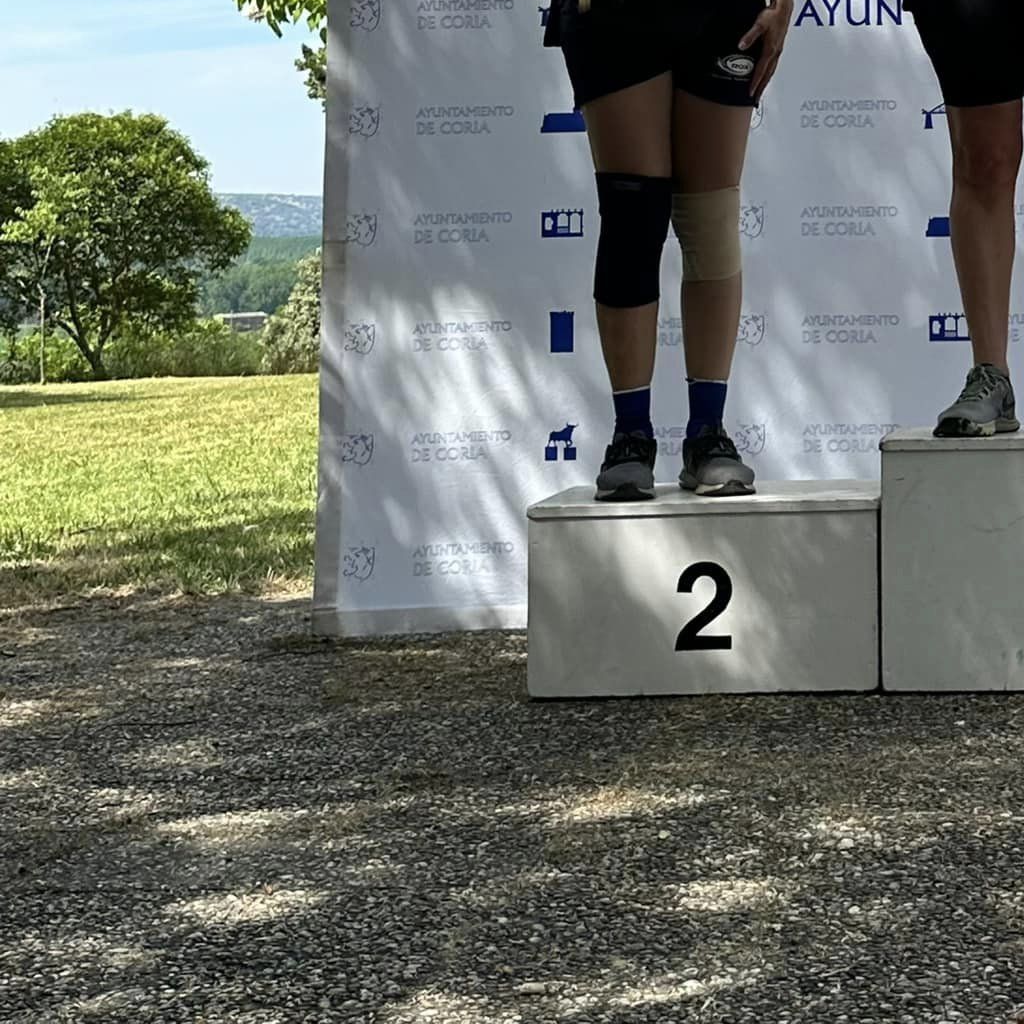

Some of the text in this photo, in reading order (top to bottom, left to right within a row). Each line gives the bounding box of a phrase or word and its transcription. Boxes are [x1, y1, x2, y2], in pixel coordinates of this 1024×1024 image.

[416, 0, 514, 13] AYUNTAMIENTO
[416, 16, 492, 30] DE CORIA
[416, 105, 514, 118] AYUNTAMIENTO
[800, 99, 897, 112] AYUNTAMIENTO
[800, 113, 875, 128] DE CORIA
[416, 120, 491, 136] DE CORIA
[414, 212, 512, 226] AYUNTAMIENTO
[800, 206, 898, 218] AYUNTAMIENTO
[800, 221, 876, 236] DE CORIA
[414, 229, 490, 244] DE CORIA
[413, 320, 512, 334] AYUNTAMIENTO
[801, 314, 900, 327] AYUNTAMIENTO
[802, 329, 878, 344] DE CORIA
[413, 337, 488, 352] DE CORIA
[411, 430, 512, 444] AYUNTAMIENTO
[803, 439, 879, 453] DE CORIA
[412, 446, 489, 462] DE CORIA
[412, 561, 432, 576] DE
[675, 562, 732, 651] 2
